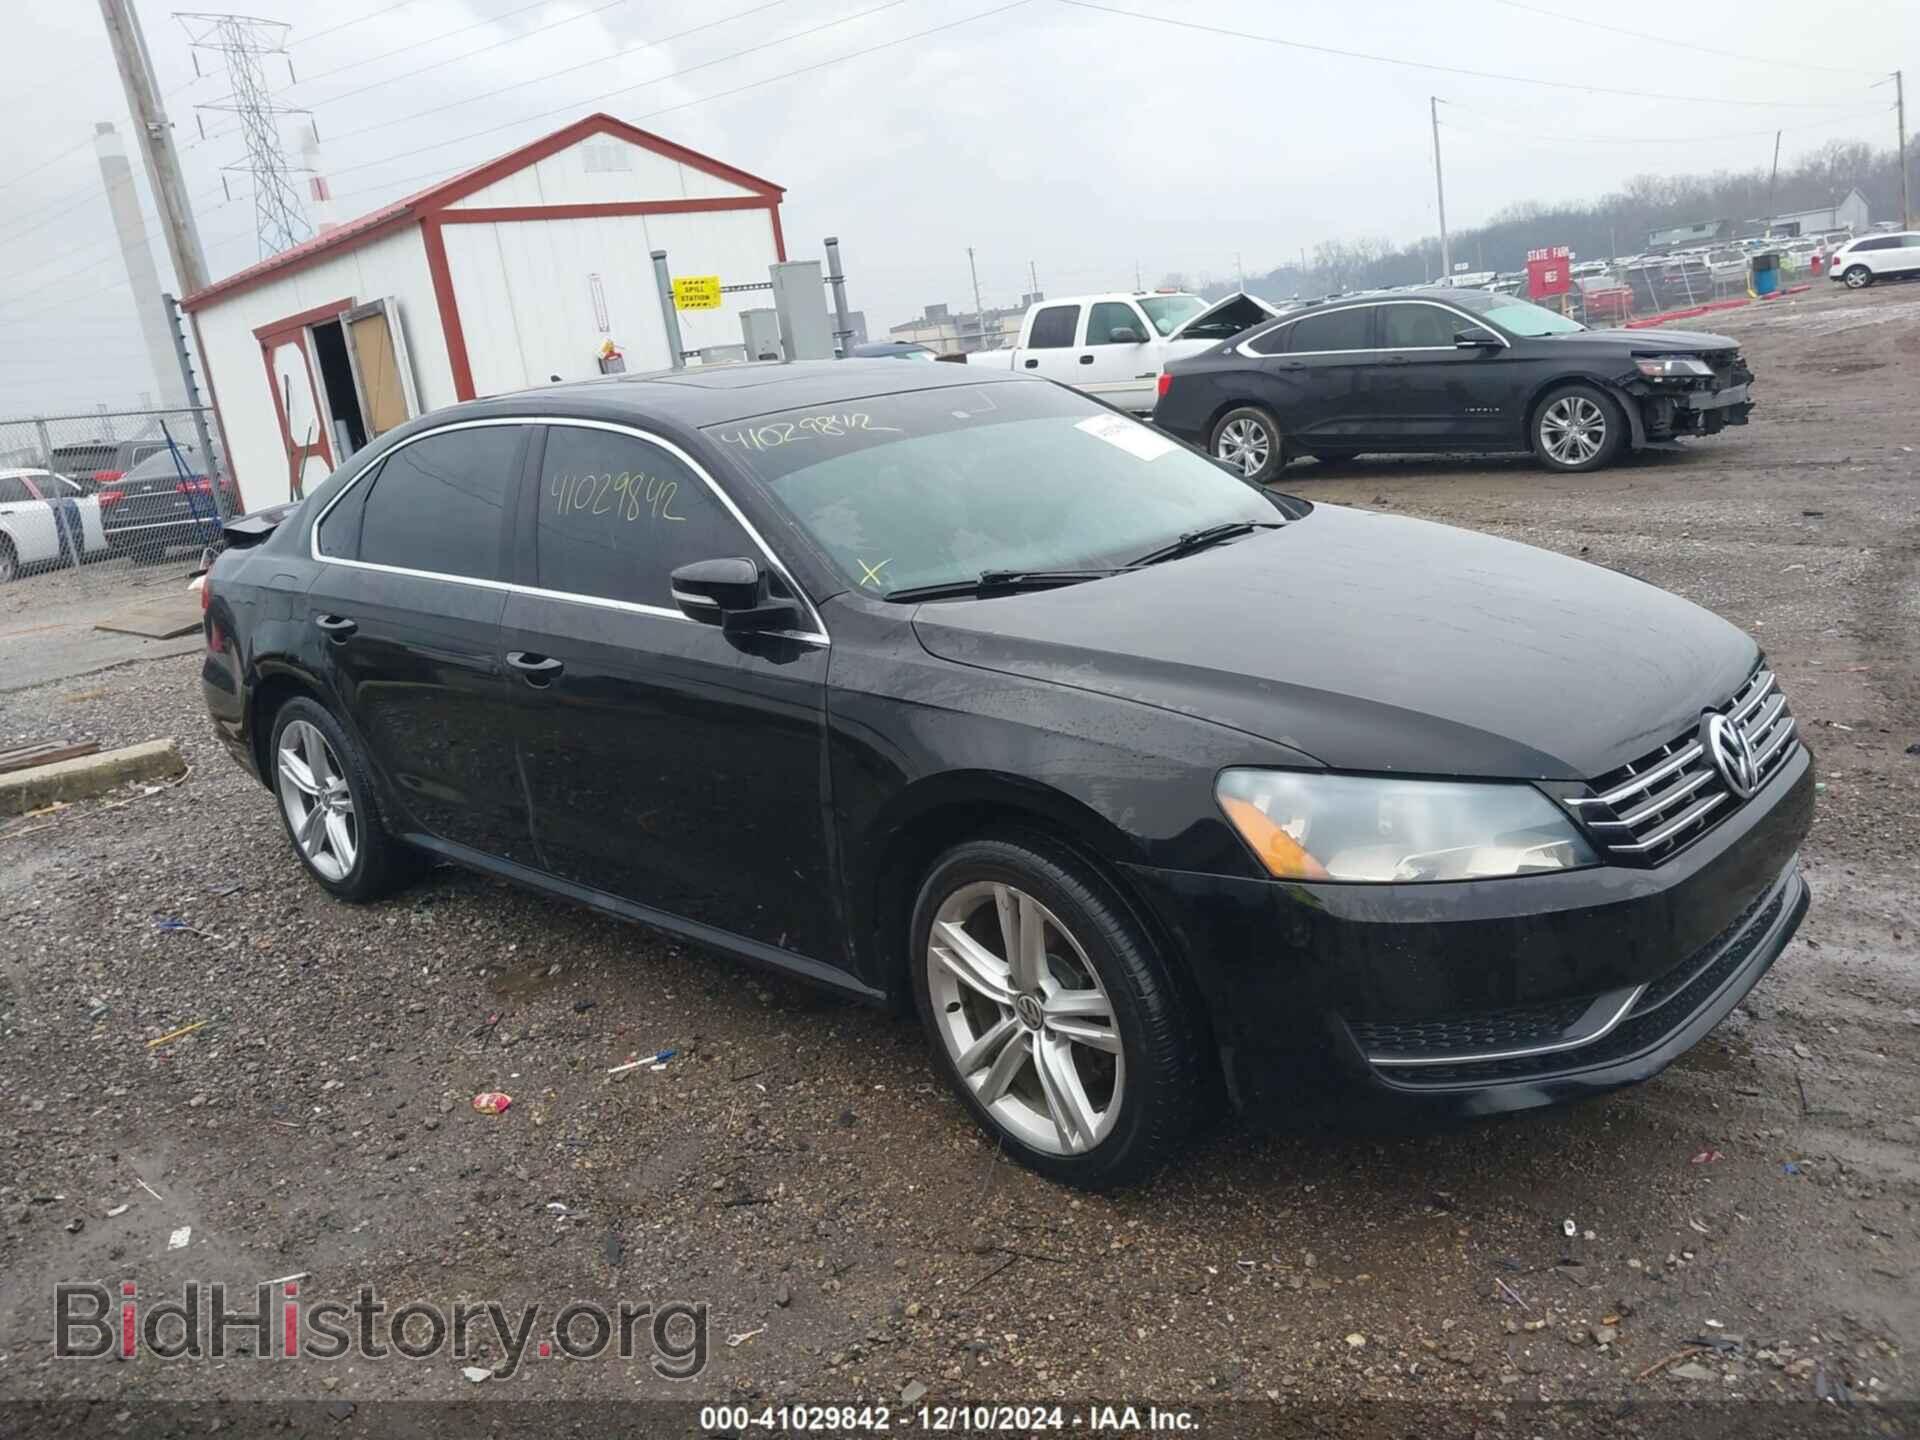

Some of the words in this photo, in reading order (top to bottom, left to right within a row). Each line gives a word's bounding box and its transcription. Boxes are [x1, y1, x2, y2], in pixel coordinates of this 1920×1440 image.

[1527, 248, 1549, 262] STATE
[721, 413, 903, 452] 41029842
[551, 471, 687, 521] 41029842
